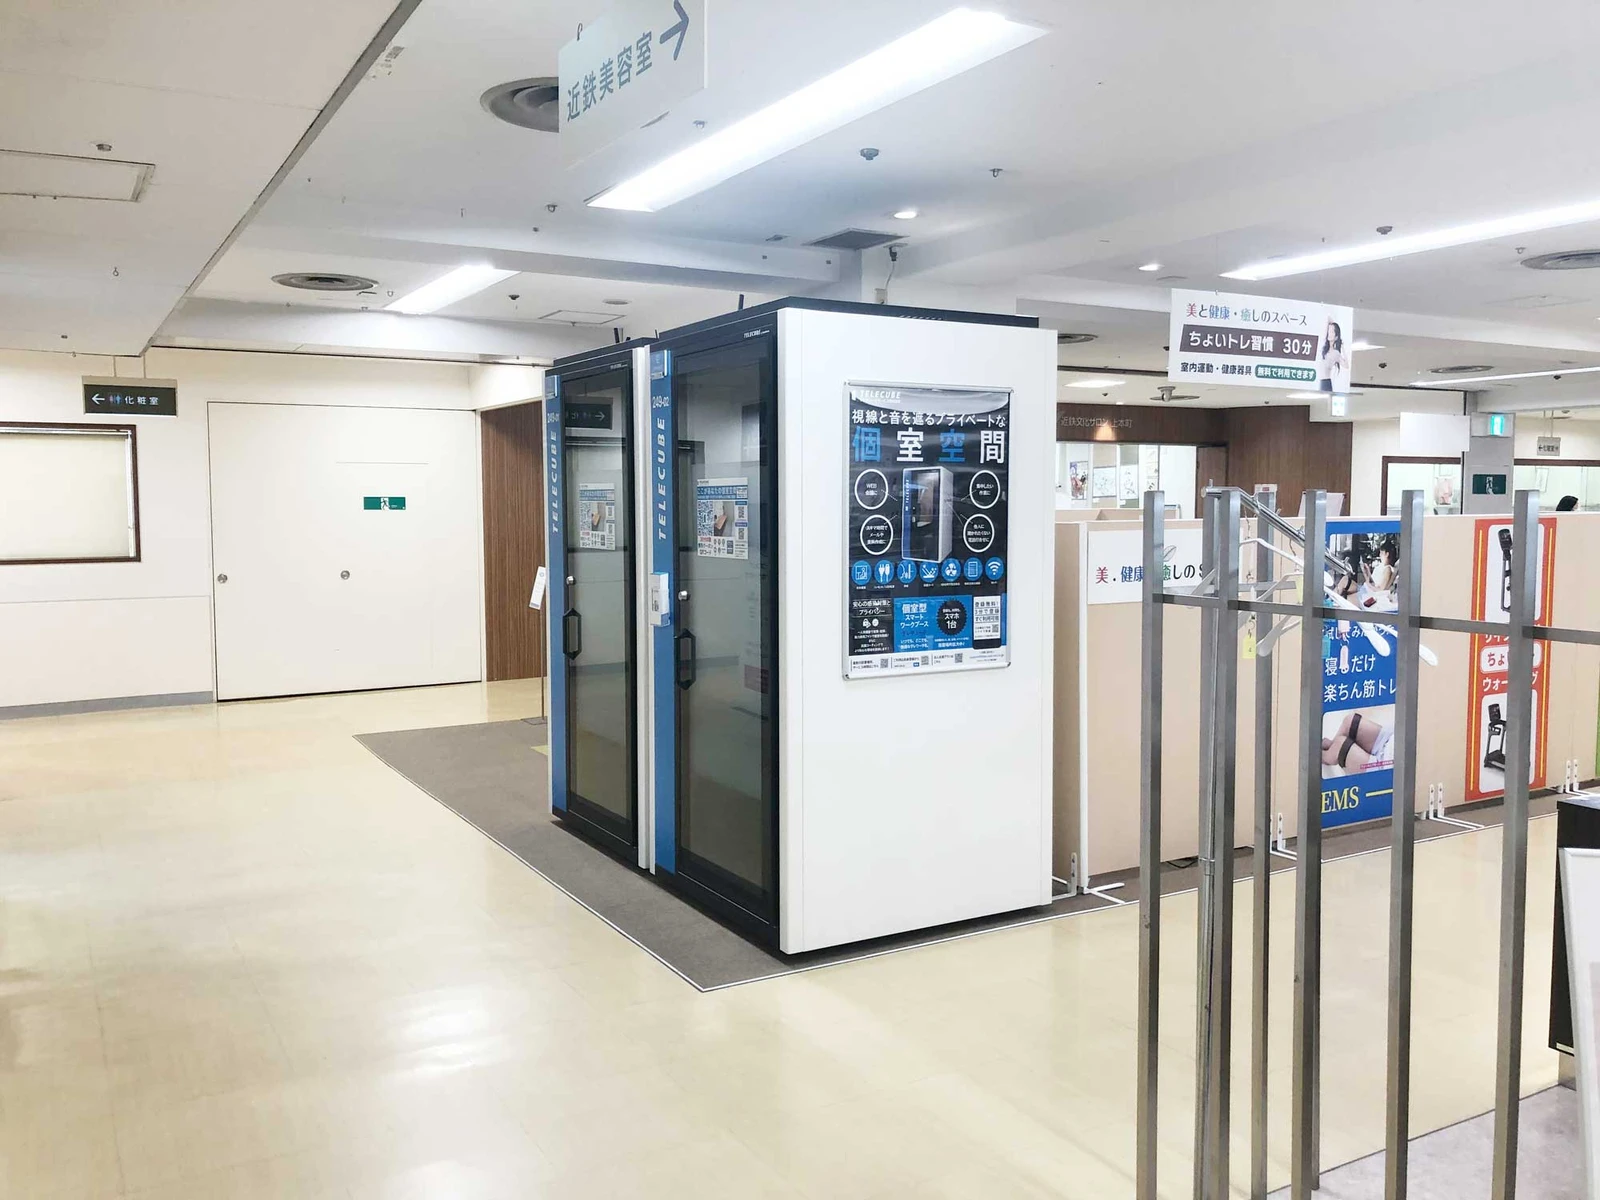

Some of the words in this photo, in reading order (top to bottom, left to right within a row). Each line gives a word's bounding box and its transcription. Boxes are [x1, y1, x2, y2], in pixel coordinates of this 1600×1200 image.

[567, 31, 653, 122] 近鉄美容室
[1186, 303, 1307, 326] 美と健康・癒しのスペース
[1189, 331, 1274, 352] ちょいトレ習慣
[1283, 338, 1312, 355] 30分
[1181, 362, 1252, 376] 室内運動・健康器具
[125, 395, 159, 405] 化粧室
[852, 409, 1007, 428] 視線と音を遮るプライベートな
[852, 426, 1006, 464] 個室空間
[550, 430, 559, 535] TELECUBE
[657, 418, 667, 541] TELECUBE
[902, 603, 927, 614] 個室型
[1324, 653, 1376, 676] 寝だけ
[1324, 678, 1397, 703] 楽ちん筋トレ
[1321, 786, 1359, 814] EMS
